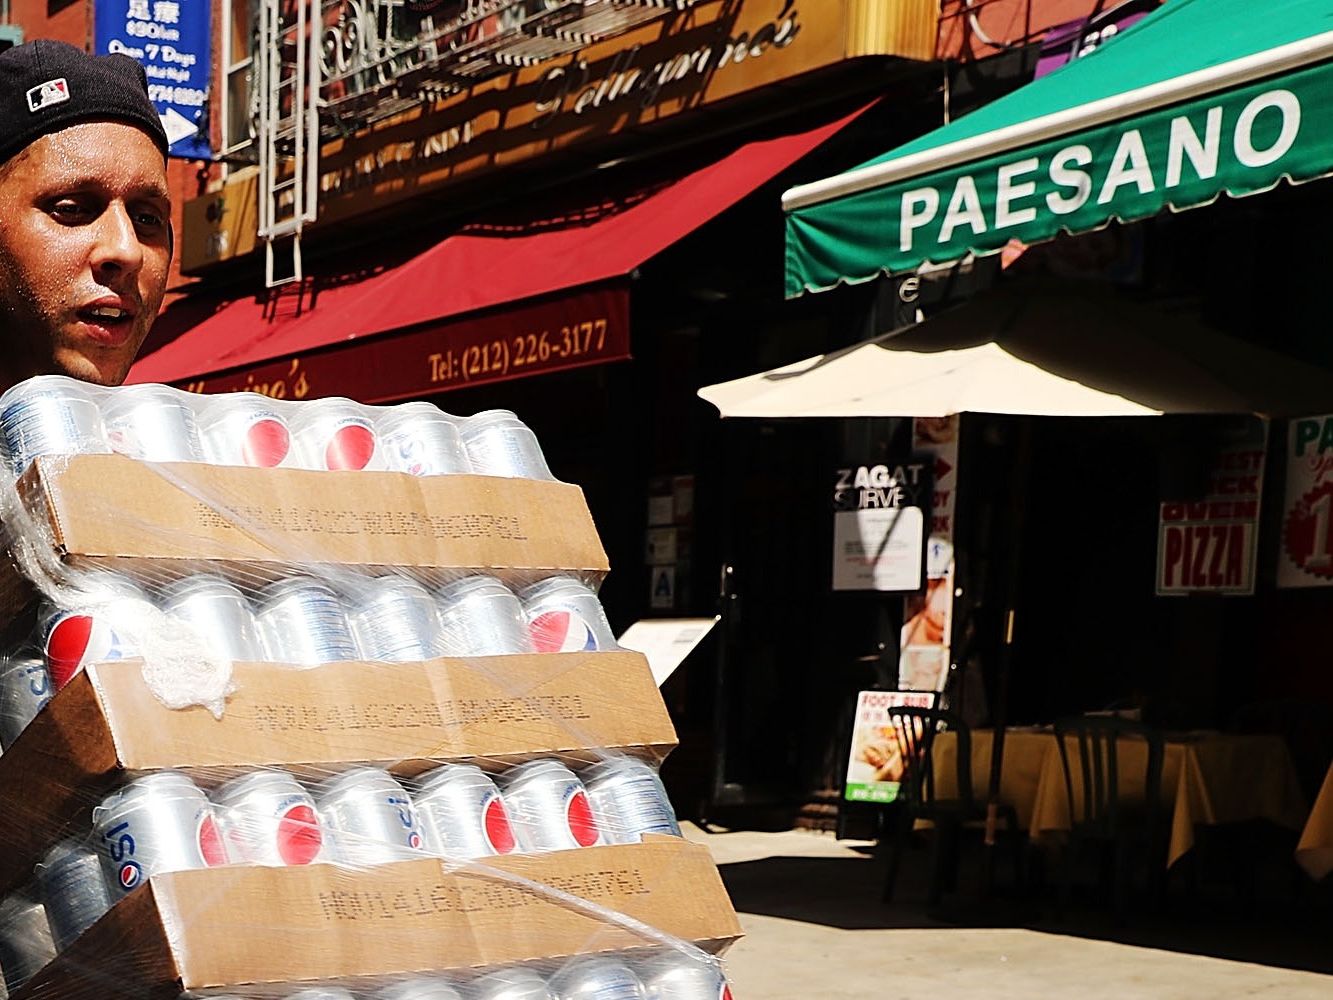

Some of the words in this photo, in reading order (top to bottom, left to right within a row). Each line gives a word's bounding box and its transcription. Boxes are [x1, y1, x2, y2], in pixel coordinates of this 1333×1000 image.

[145, 43, 159, 60] 7
[161, 45, 196, 67] Days
[899, 88, 1302, 253] PAESANO
[429, 353, 459, 382] Tel:
[462, 340, 510, 379] (212)
[513, 318, 609, 368] 226-3177
[834, 486, 924, 508] SURVEY
[836, 464, 924, 490] ZAGAT
[1164, 525, 1245, 588] PIZZA
